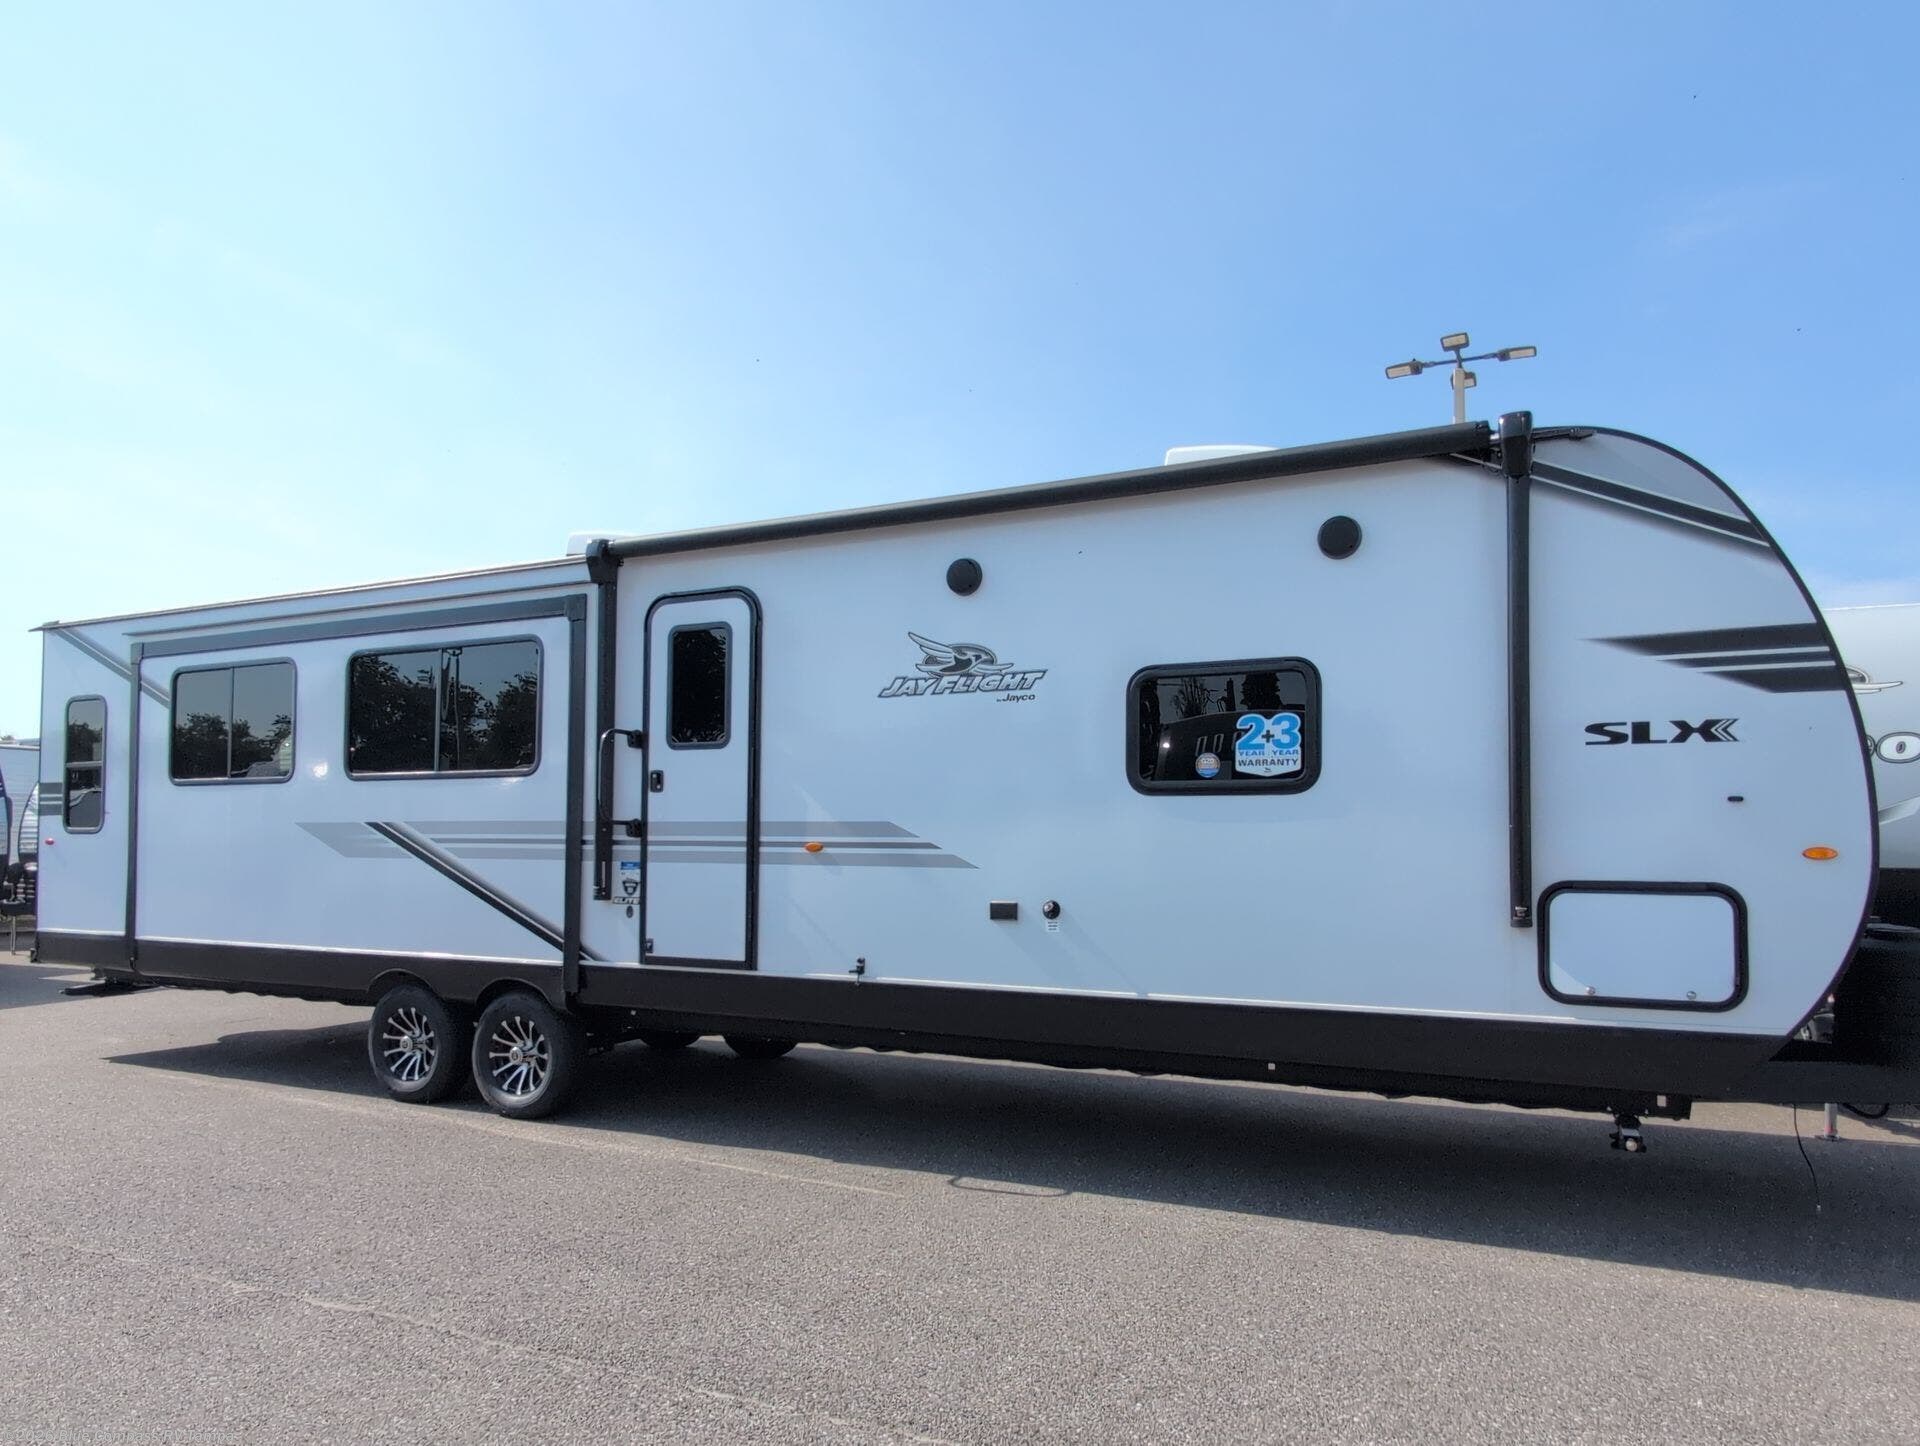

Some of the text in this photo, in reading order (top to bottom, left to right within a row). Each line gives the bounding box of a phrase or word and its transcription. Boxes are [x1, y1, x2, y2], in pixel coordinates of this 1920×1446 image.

[878, 669, 1048, 698] JAY FLIGHT
[1002, 693, 1036, 703] Jayco
[1584, 718, 1739, 746] SLX
[1272, 749, 1299, 757] YEAR
[1238, 758, 1299, 767] WARRANTY
